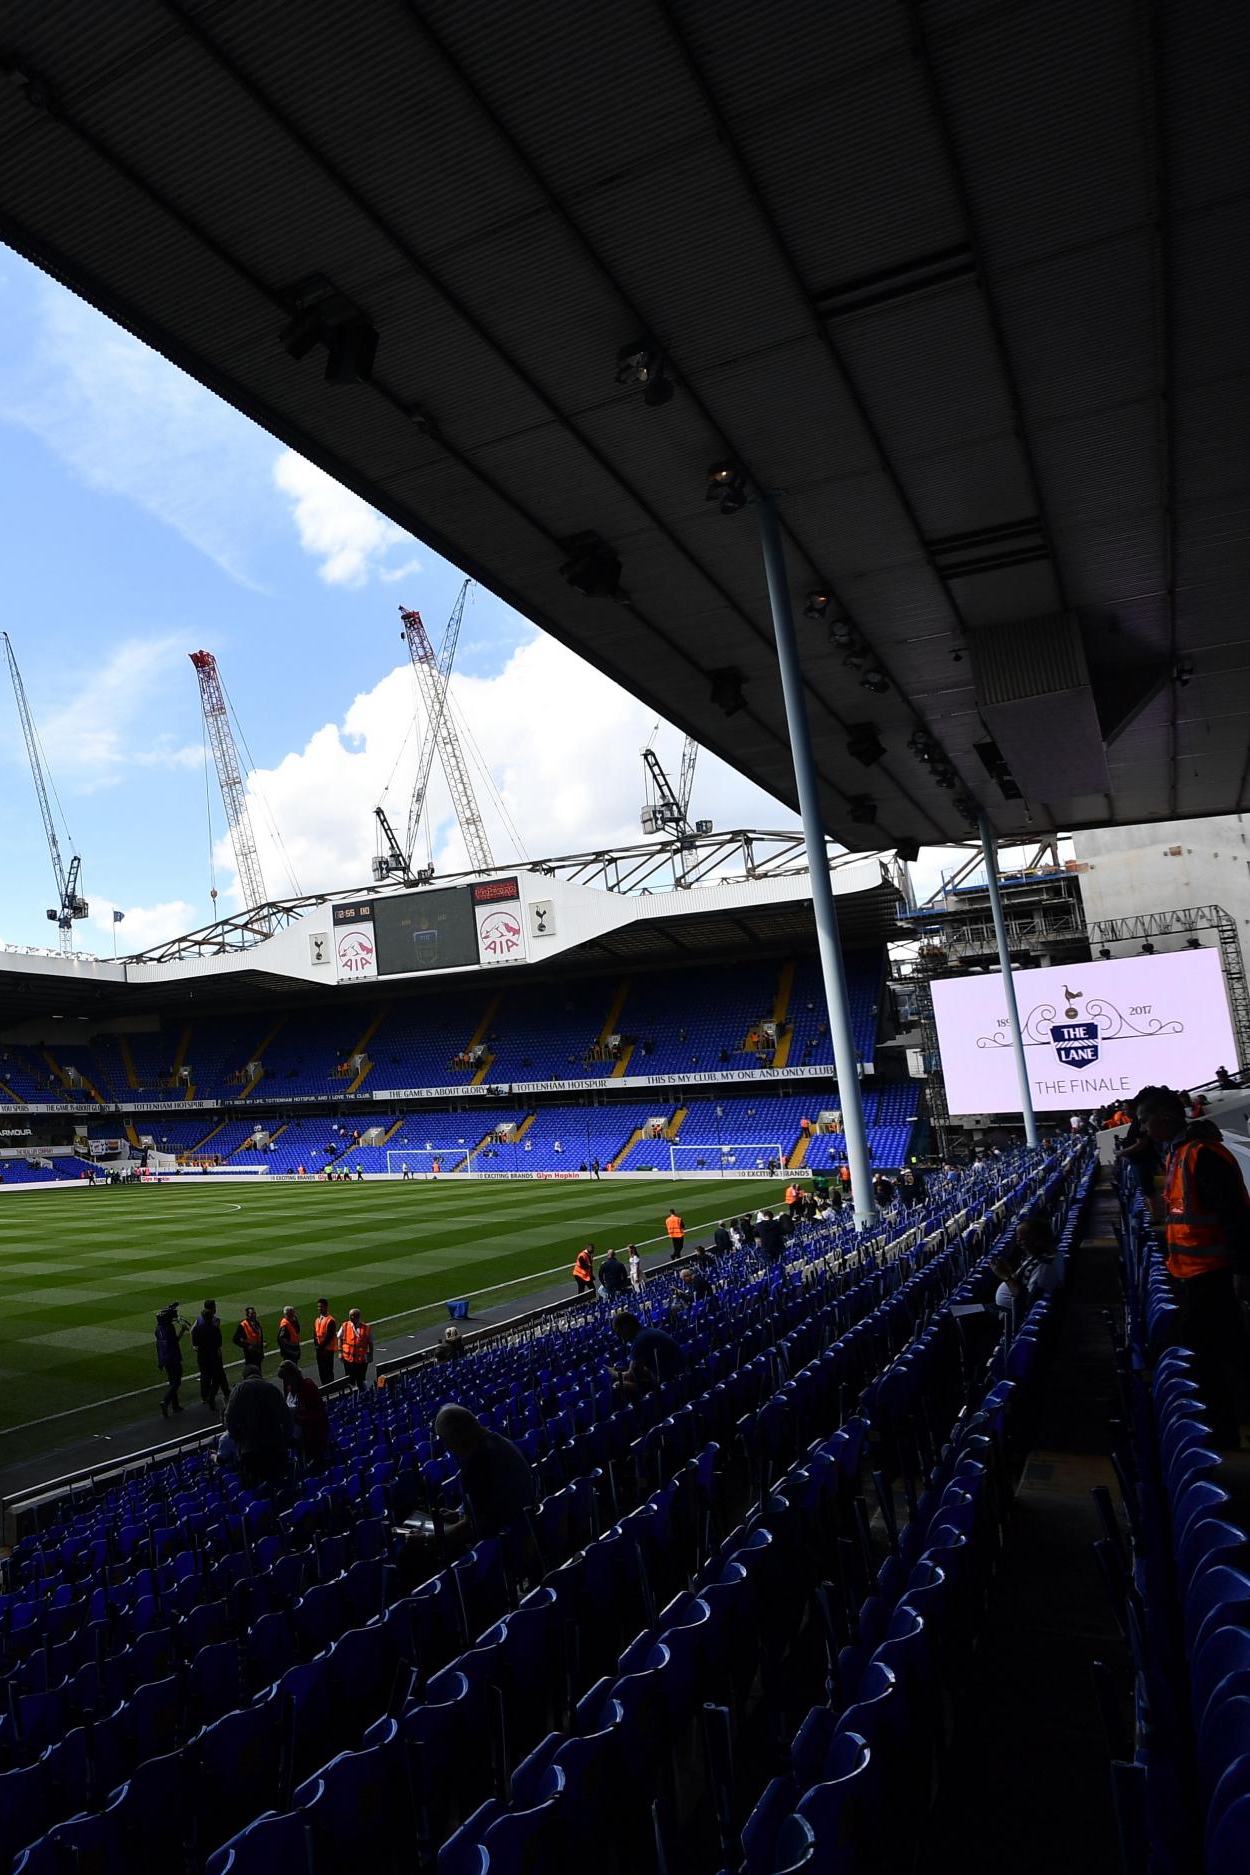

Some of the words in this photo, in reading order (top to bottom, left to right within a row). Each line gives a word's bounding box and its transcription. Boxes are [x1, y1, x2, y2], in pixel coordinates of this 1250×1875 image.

[485, 939, 518, 954] AIA
[342, 956, 372, 971] AIA
[1129, 1005, 1152, 1016] 2017
[997, 1018, 1011, 1028] 189
[1061, 1026, 1089, 1040] THE
[1061, 1048, 1097, 1062] LANE
[647, 1075, 666, 1084] THIS
[668, 1075, 676, 1083] IS
[678, 1074, 692, 1082] MY
[721, 1072, 735, 1080] MY
[737, 1071, 757, 1080] ONE
[759, 1070, 780, 1078] AND
[782, 1068, 806, 1078] ONLY
[516, 1082, 566, 1092] TOTTENHAM
[568, 1080, 608, 1090] HOTSPUR
[1035, 1080, 1067, 1094] THE
[1070, 1076, 1131, 1093] FINALE
[389, 1090, 403, 1098] THE
[404, 1090, 425, 1098] GAME
[434, 1088, 460, 1096] ABOUT
[462, 1086, 486, 1095] GLORY
[134, 1102, 172, 1110] TOTTENHAM
[174, 1101, 204, 1109] HOTSPUR
[536, 1172, 552, 1180] Glyn
